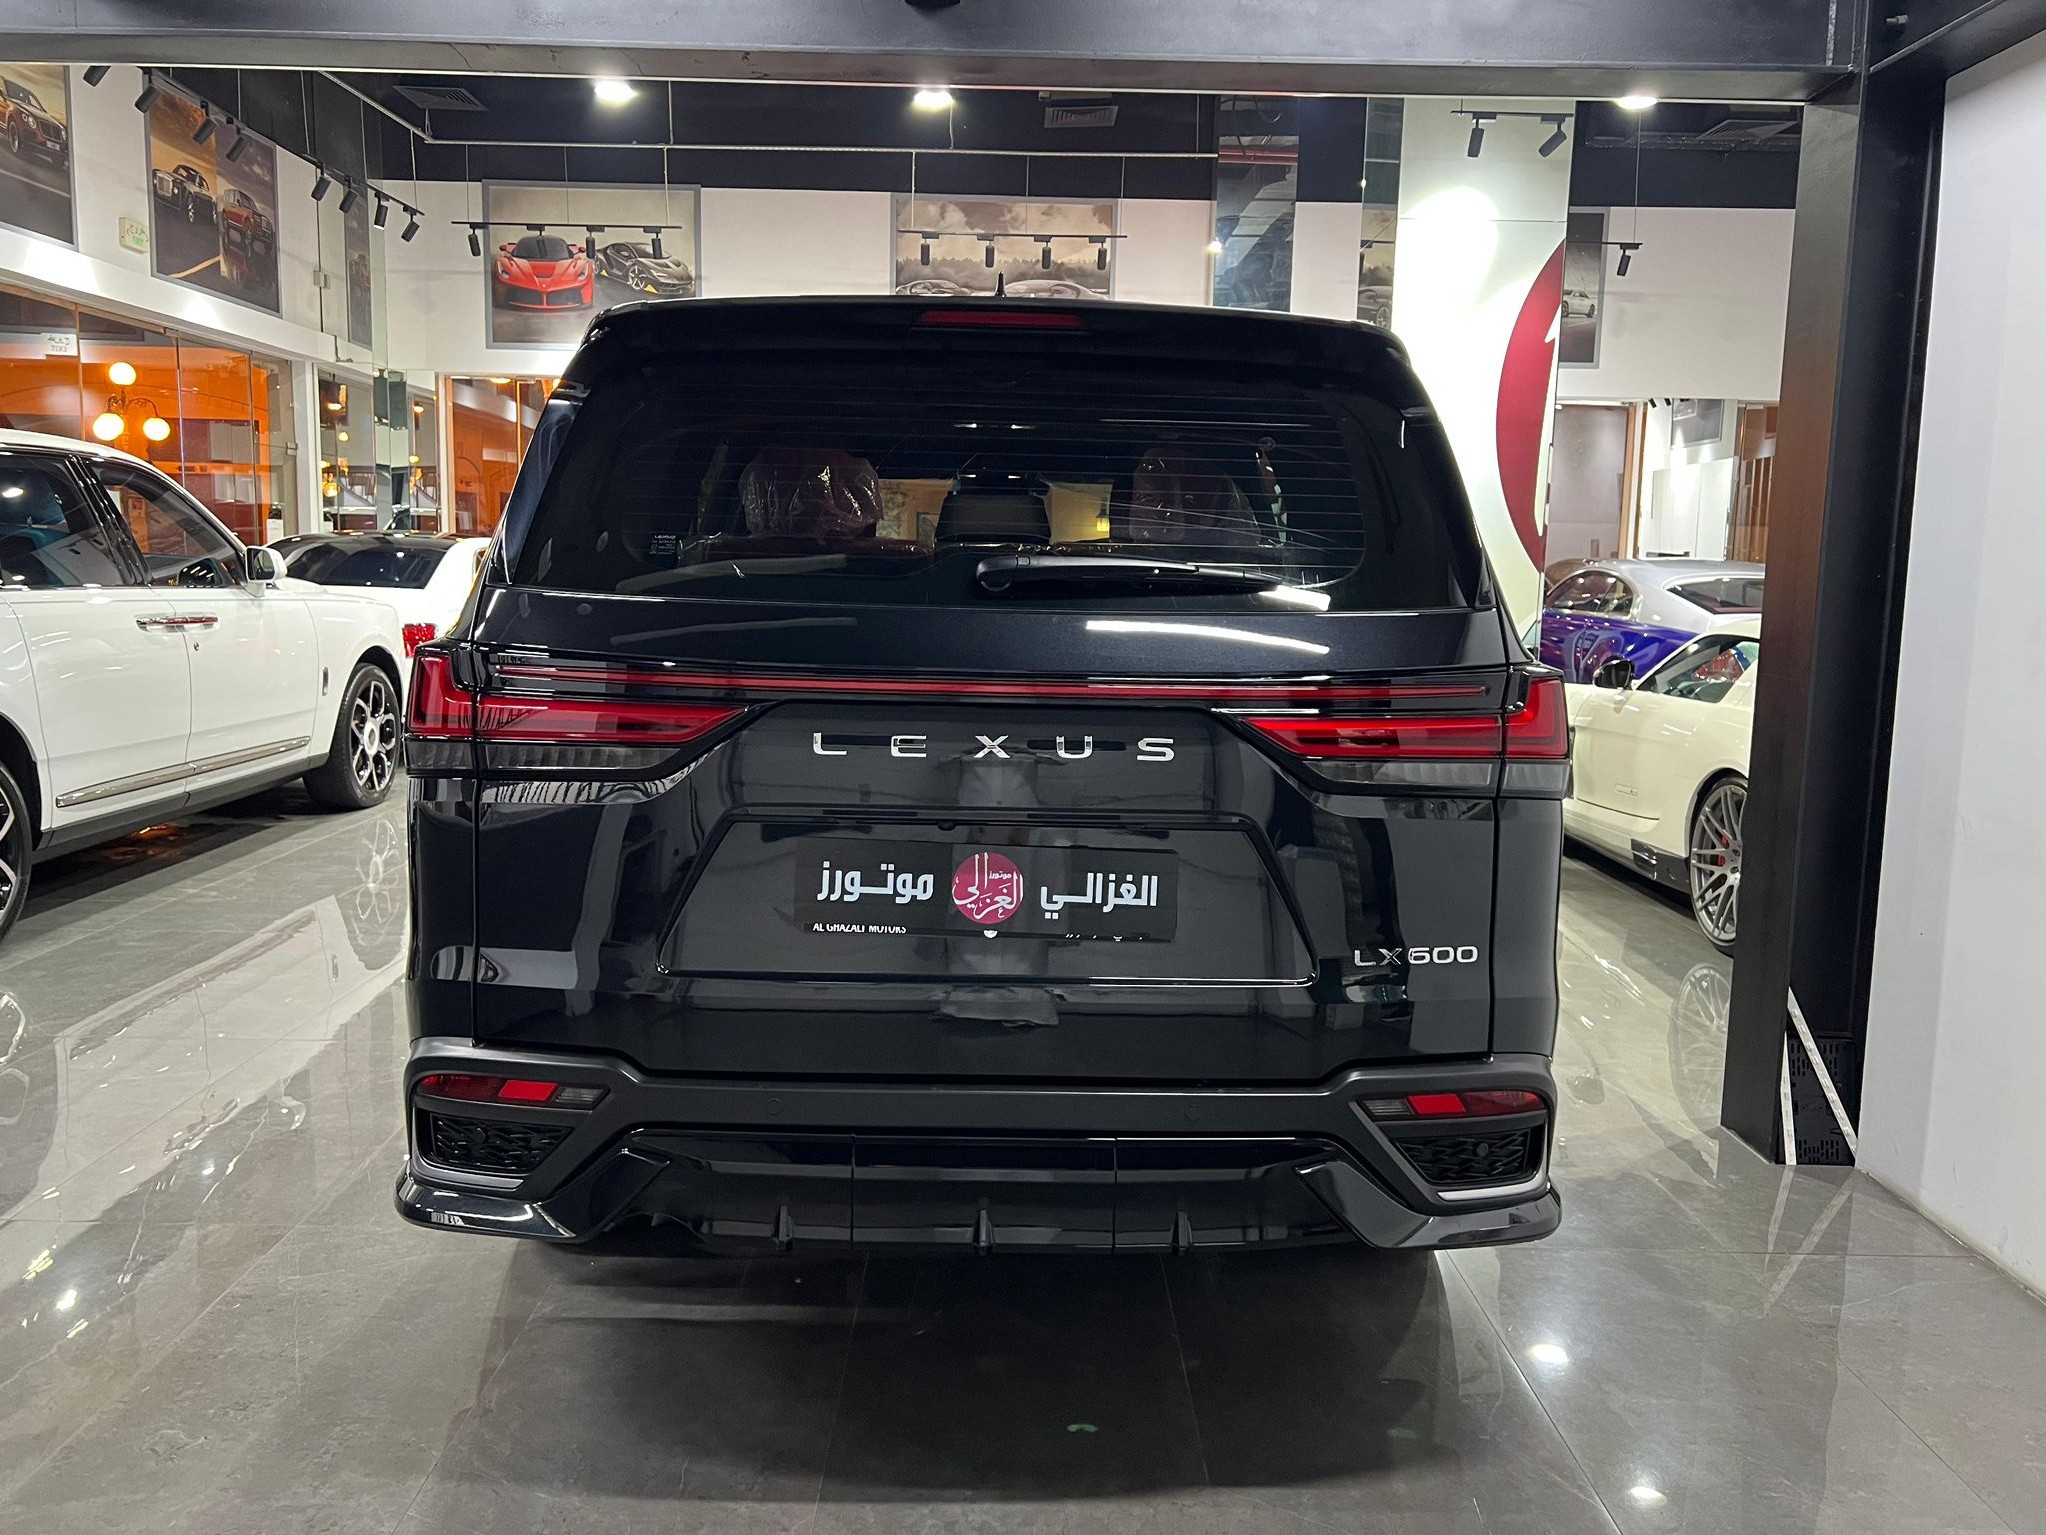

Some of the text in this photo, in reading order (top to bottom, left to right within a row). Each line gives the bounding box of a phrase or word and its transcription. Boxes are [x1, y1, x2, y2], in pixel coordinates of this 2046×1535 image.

[812, 732, 1175, 762] LEXUS
[816, 860, 1158, 920] الغزالي موتورز
[812, 922, 825, 932] AL
